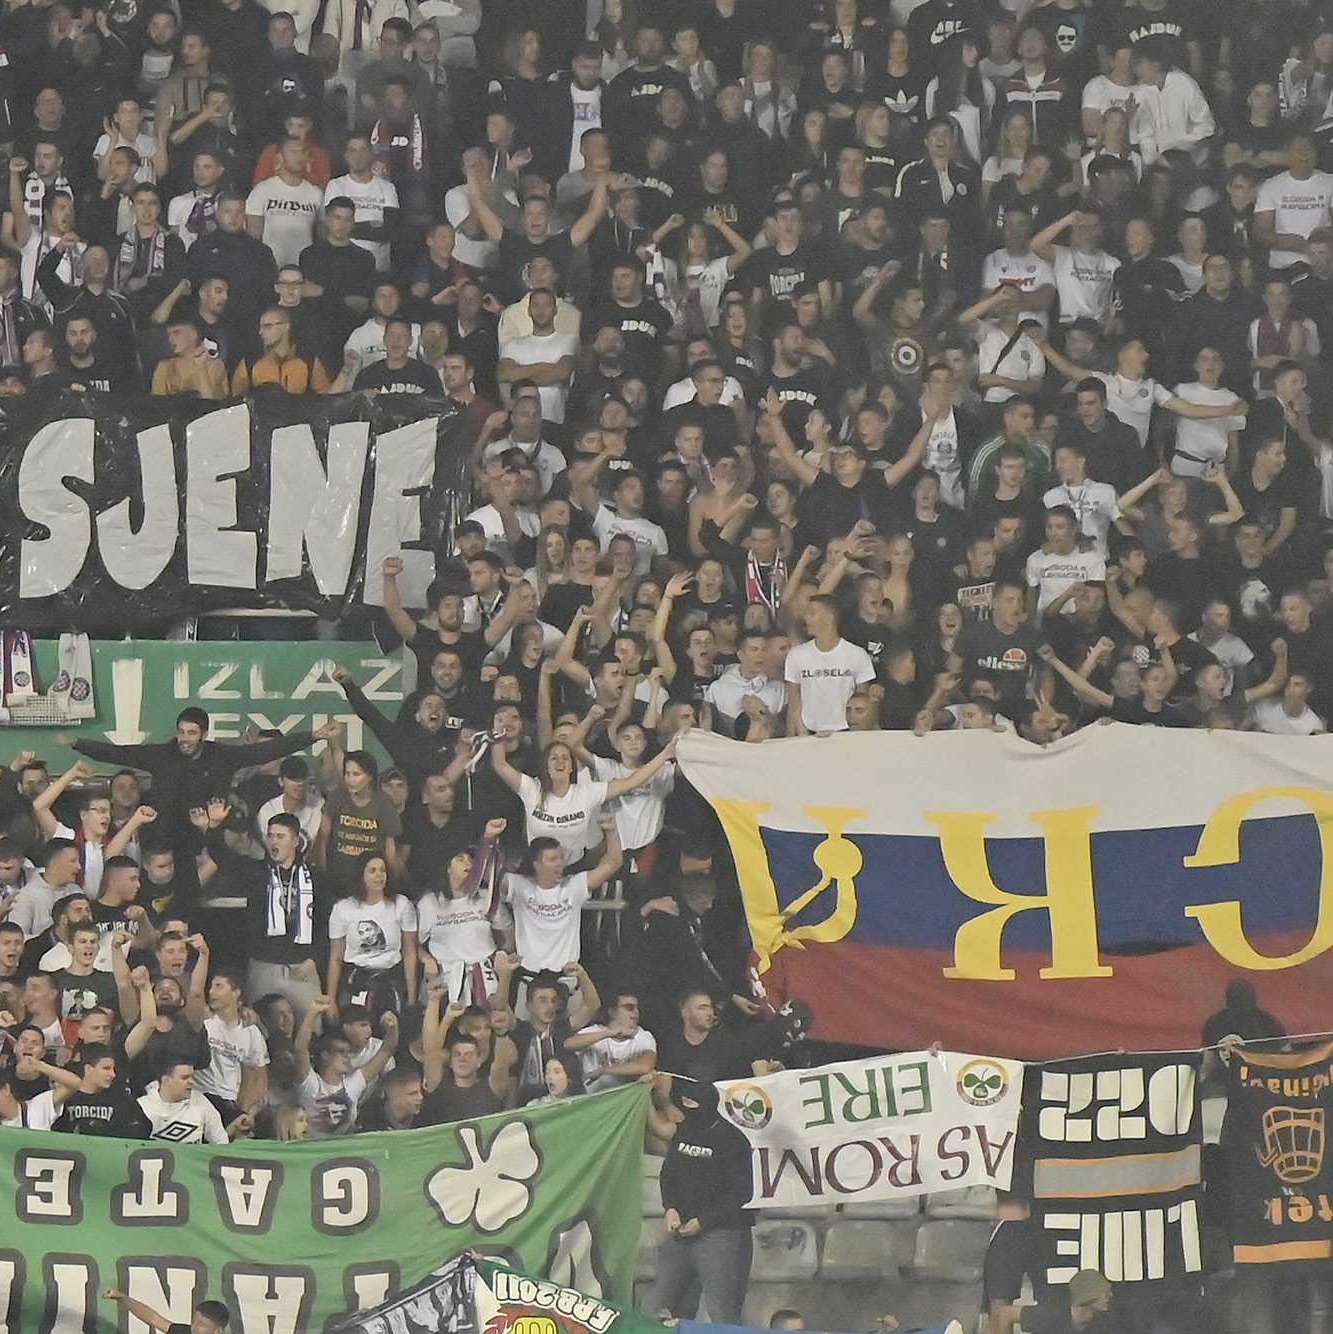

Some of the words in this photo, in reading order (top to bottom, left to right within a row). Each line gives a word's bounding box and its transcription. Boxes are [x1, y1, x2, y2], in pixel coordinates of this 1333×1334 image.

[18, 404, 438, 609] SJENE
[173, 659, 405, 701] IZLAZ
[800, 1060, 932, 1129] EIRE
[760, 1133, 925, 1200] ROM
[938, 1123, 1015, 1180] AS
[24, 1149, 371, 1227] GATE
